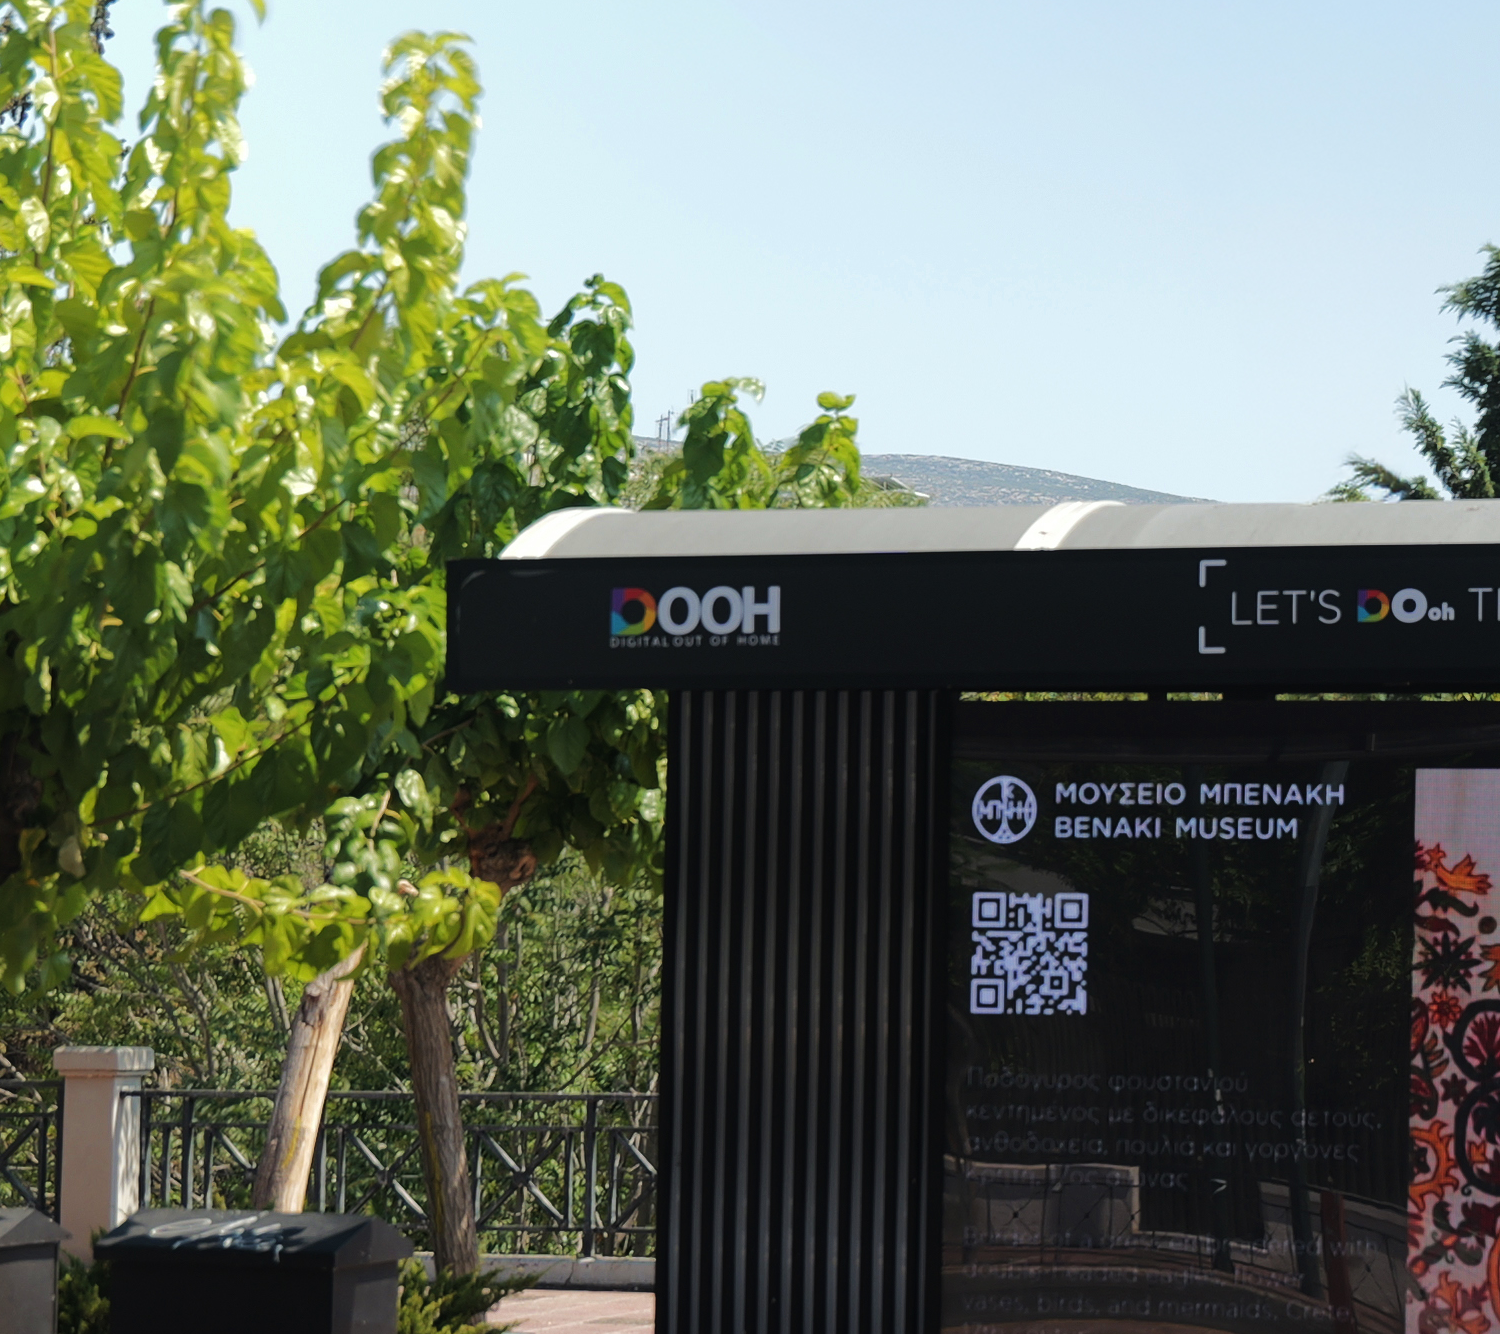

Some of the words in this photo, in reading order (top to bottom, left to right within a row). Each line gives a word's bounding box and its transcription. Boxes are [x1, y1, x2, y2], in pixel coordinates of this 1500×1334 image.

[609, 586, 782, 636] DOOH
[1231, 588, 1343, 625] LET'S
[609, 636, 670, 649] DIGITAL
[671, 636, 703, 649] OUT
[708, 636, 730, 648] OF
[735, 634, 782, 648] HOME
[1054, 782, 1187, 806] ΜΟΥΣΕΙΟ
[1200, 783, 1345, 807] ΜΠΕΝΑΚΗ
[1054, 816, 1162, 839] BENAKI
[1176, 817, 1299, 840] MUSEUM
[1108, 1106, 1134, 1126] με
[1203, 1139, 1237, 1158] και
[1107, 1297, 1152, 1318] and
